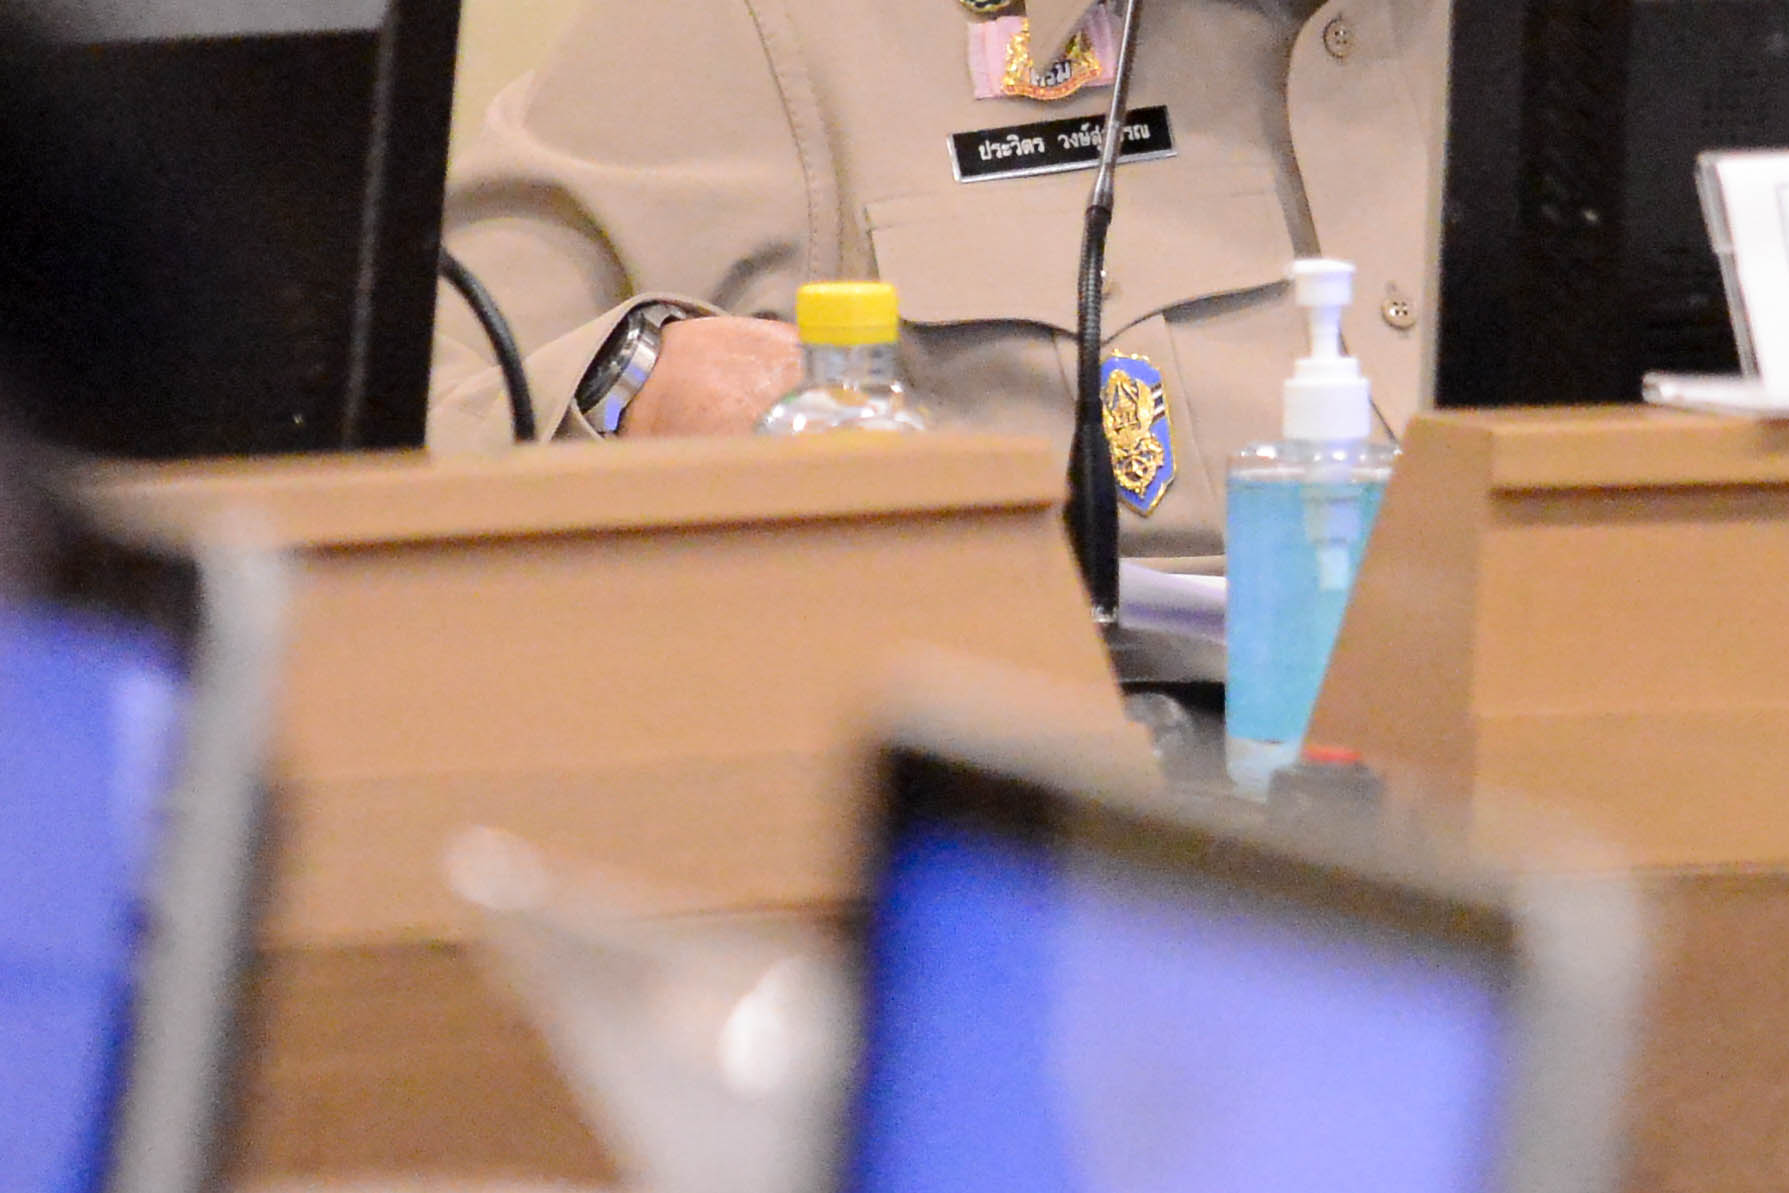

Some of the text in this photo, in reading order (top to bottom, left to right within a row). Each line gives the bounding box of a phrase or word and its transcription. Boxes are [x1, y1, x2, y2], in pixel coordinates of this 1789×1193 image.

[978, 122, 1151, 161] ประวิตร วงษ์สุรณ
